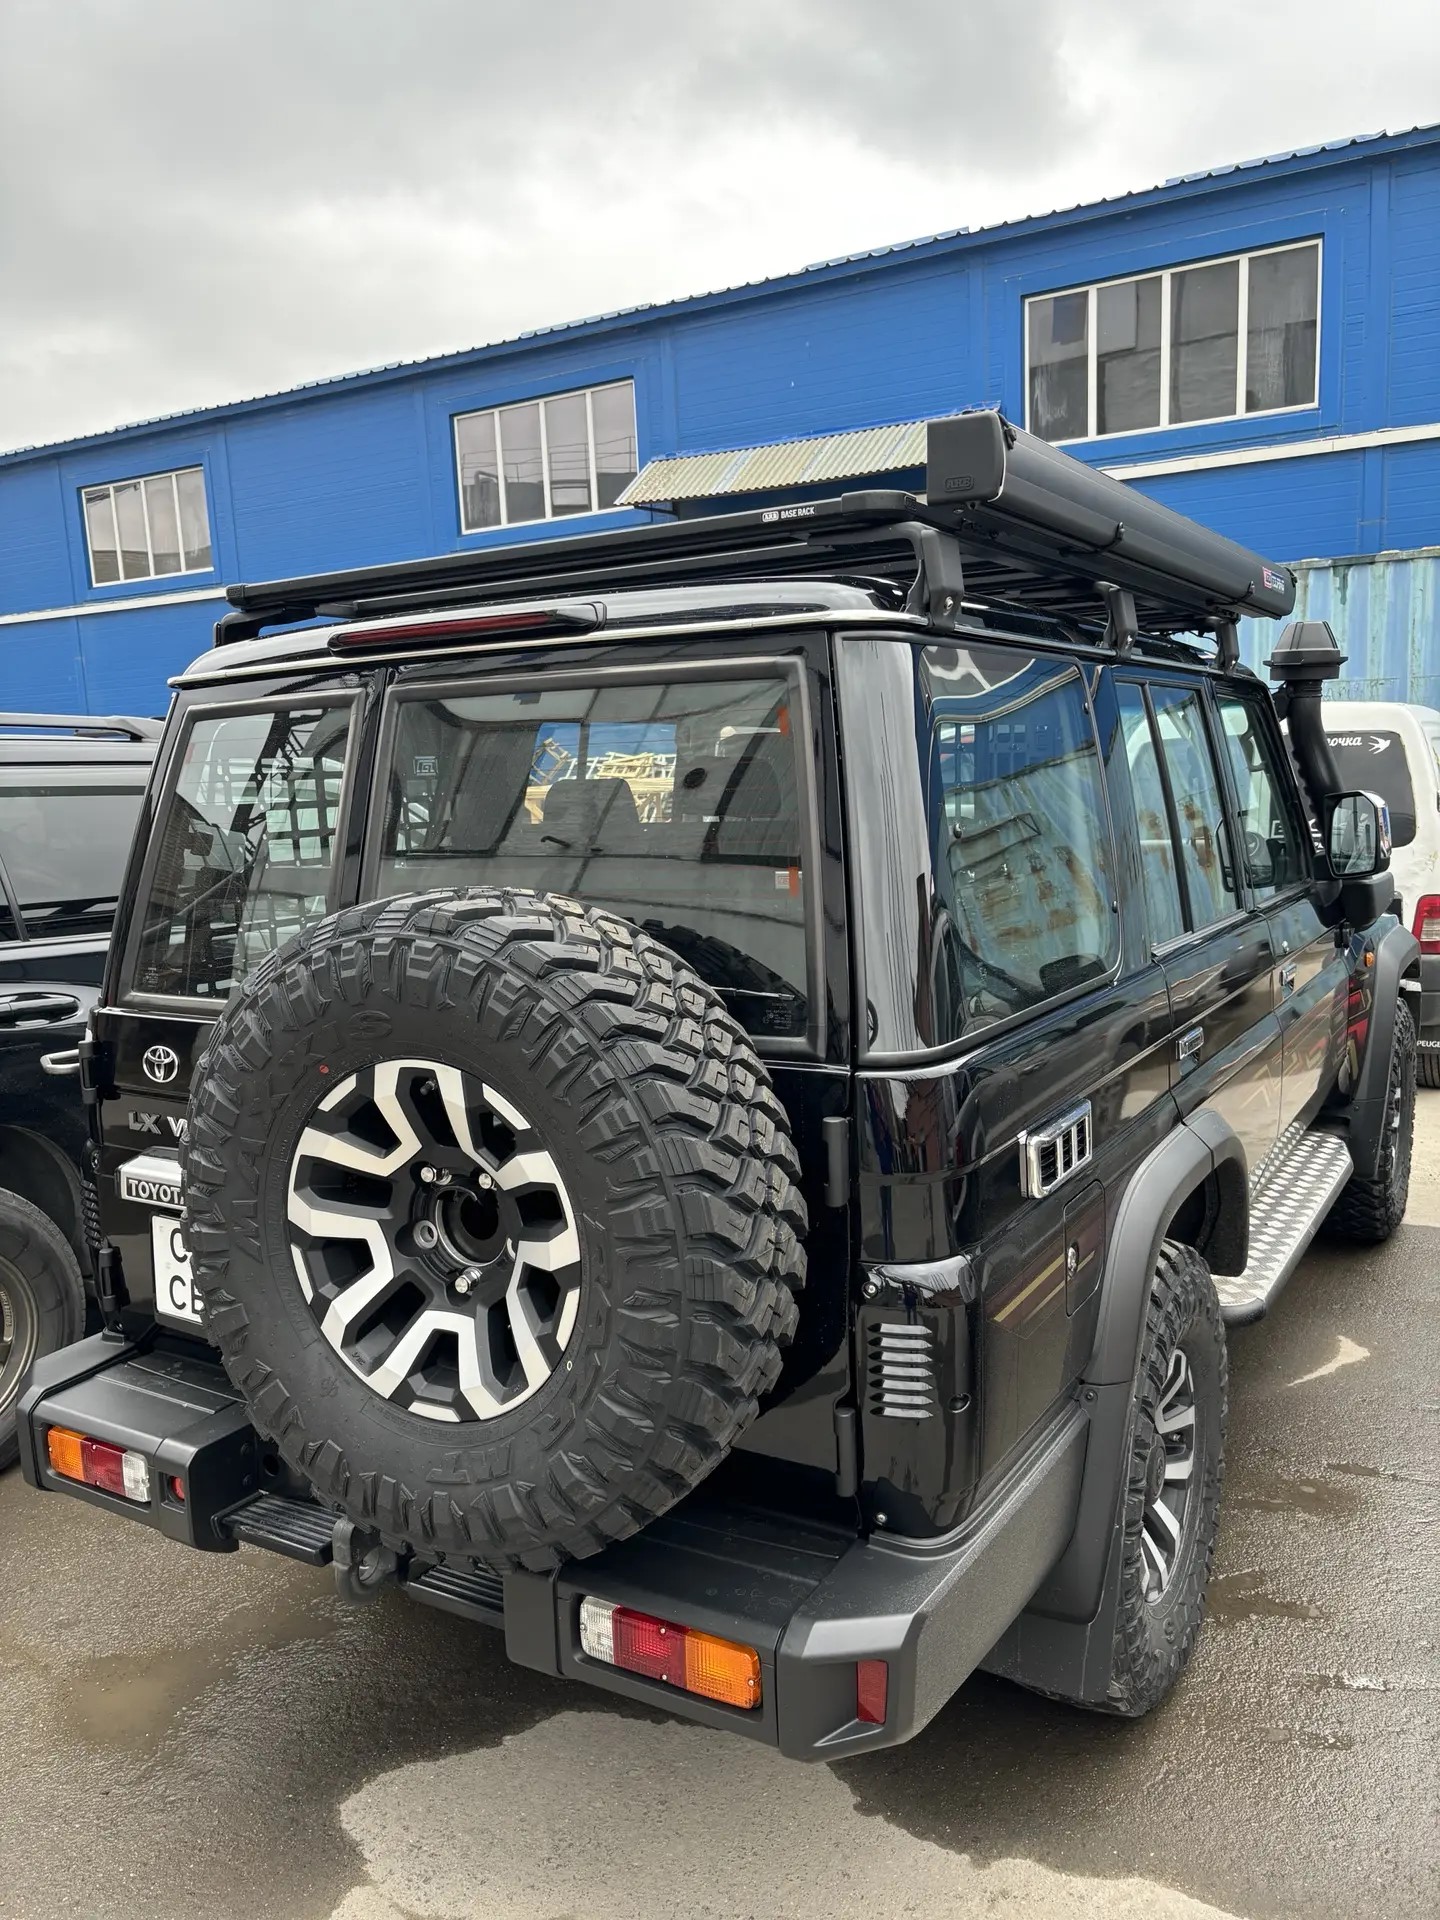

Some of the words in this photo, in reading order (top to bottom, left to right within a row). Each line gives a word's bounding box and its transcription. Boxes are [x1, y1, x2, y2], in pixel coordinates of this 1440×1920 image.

[781, 509, 797, 519] BASE
[798, 506, 815, 517] RACK
[1327, 736, 1363, 747] очка
[128, 1110, 162, 1135] LX
